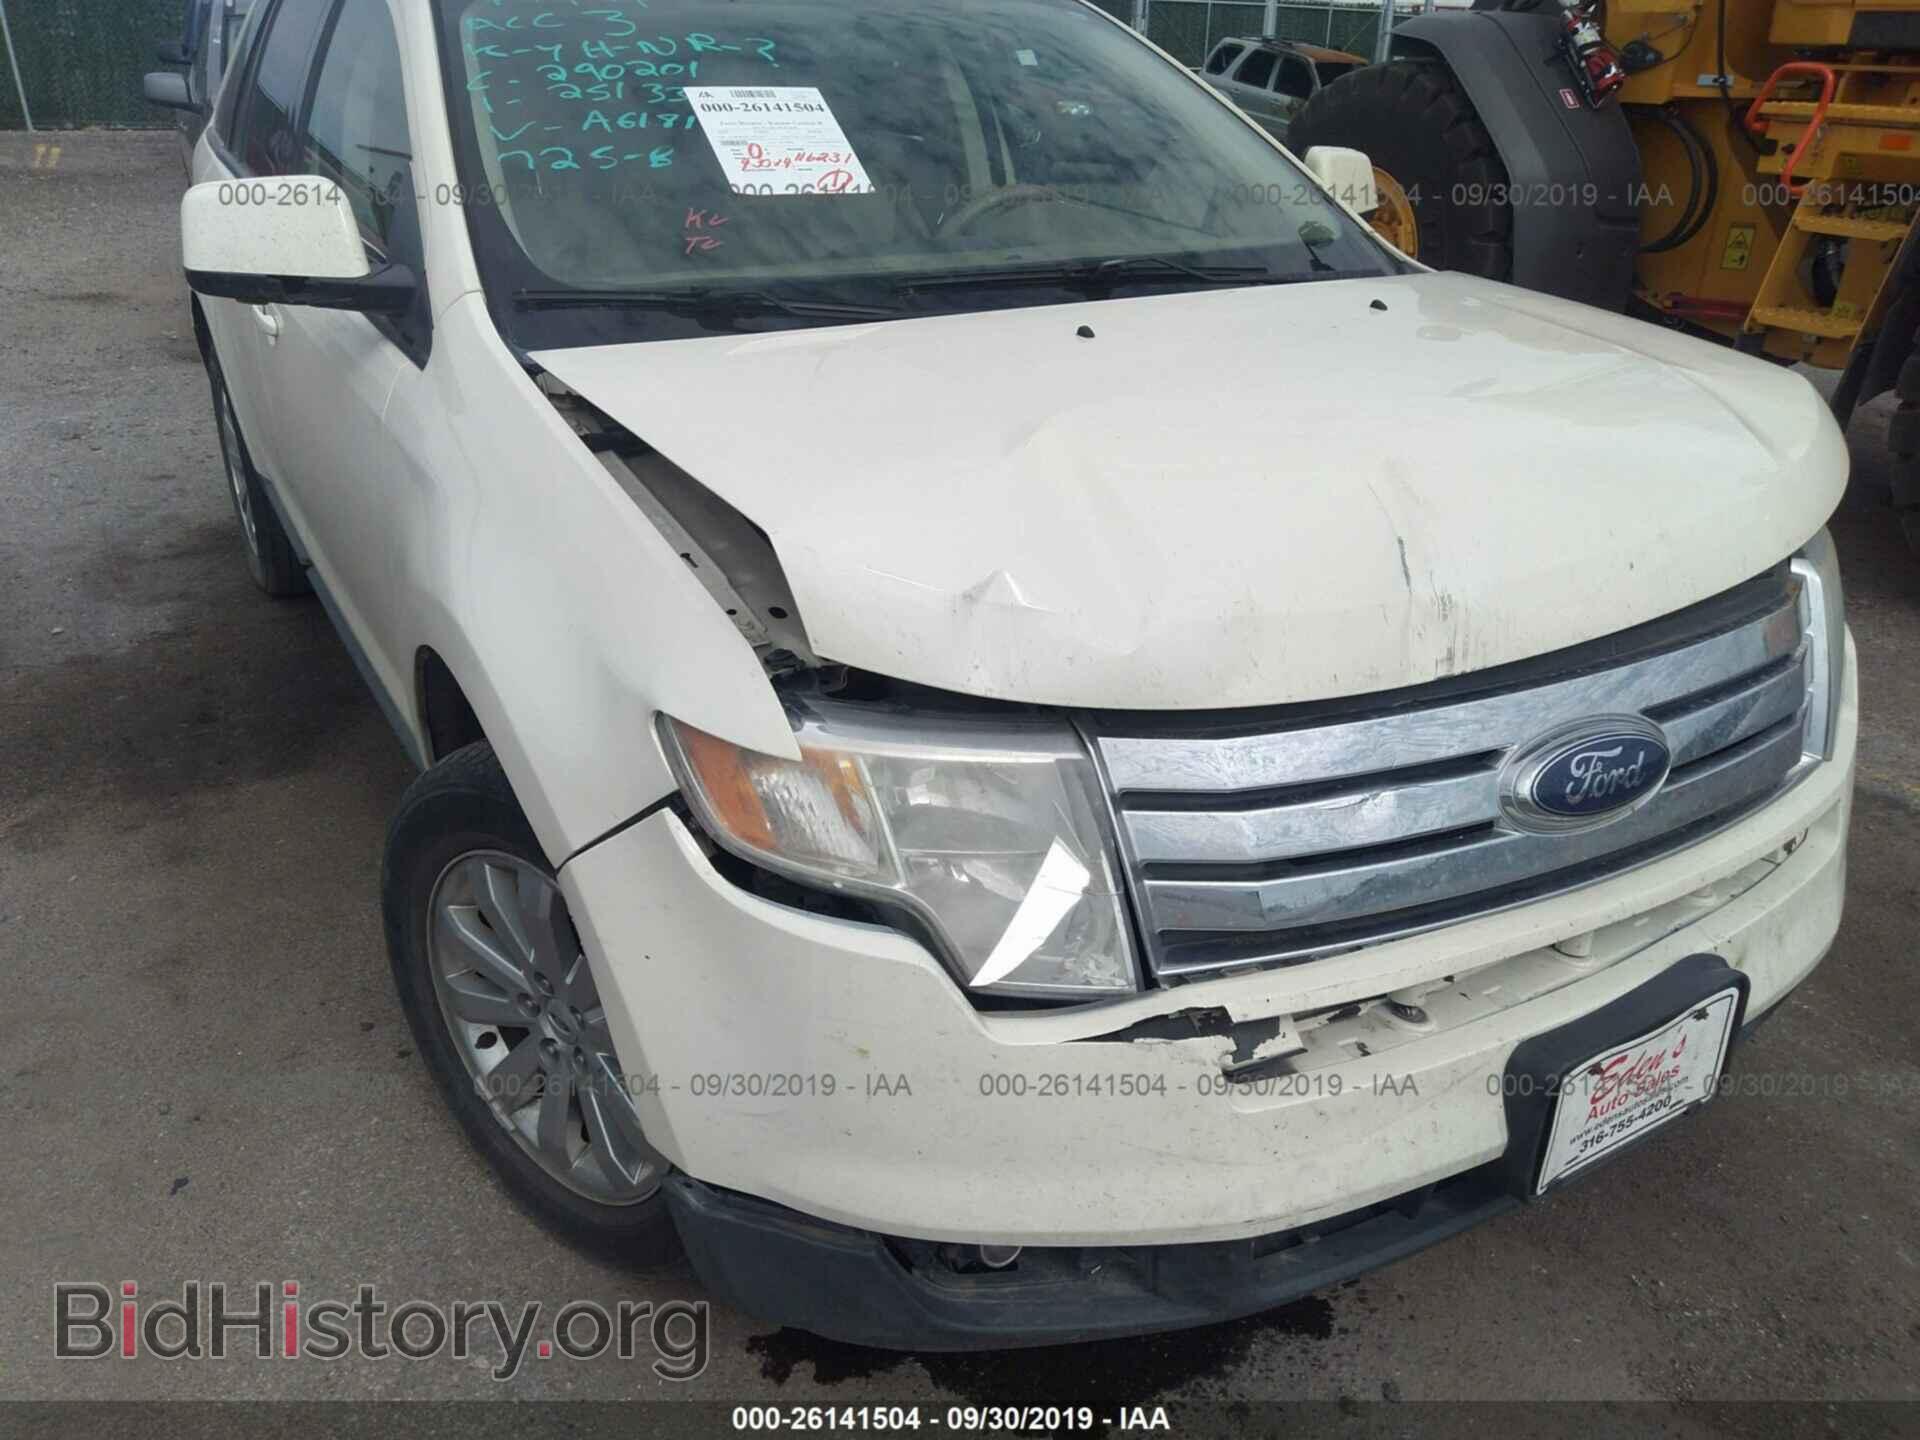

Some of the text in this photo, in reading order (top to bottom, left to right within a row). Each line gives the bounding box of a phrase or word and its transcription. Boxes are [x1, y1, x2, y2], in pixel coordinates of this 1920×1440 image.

[581, 10, 637, 36] 3
[699, 102, 826, 113] 000-26141504
[1566, 746, 1647, 804] Ford
[1579, 1094, 1672, 1153] 316-755-4200
[1584, 1093, 1629, 1126] Auto
